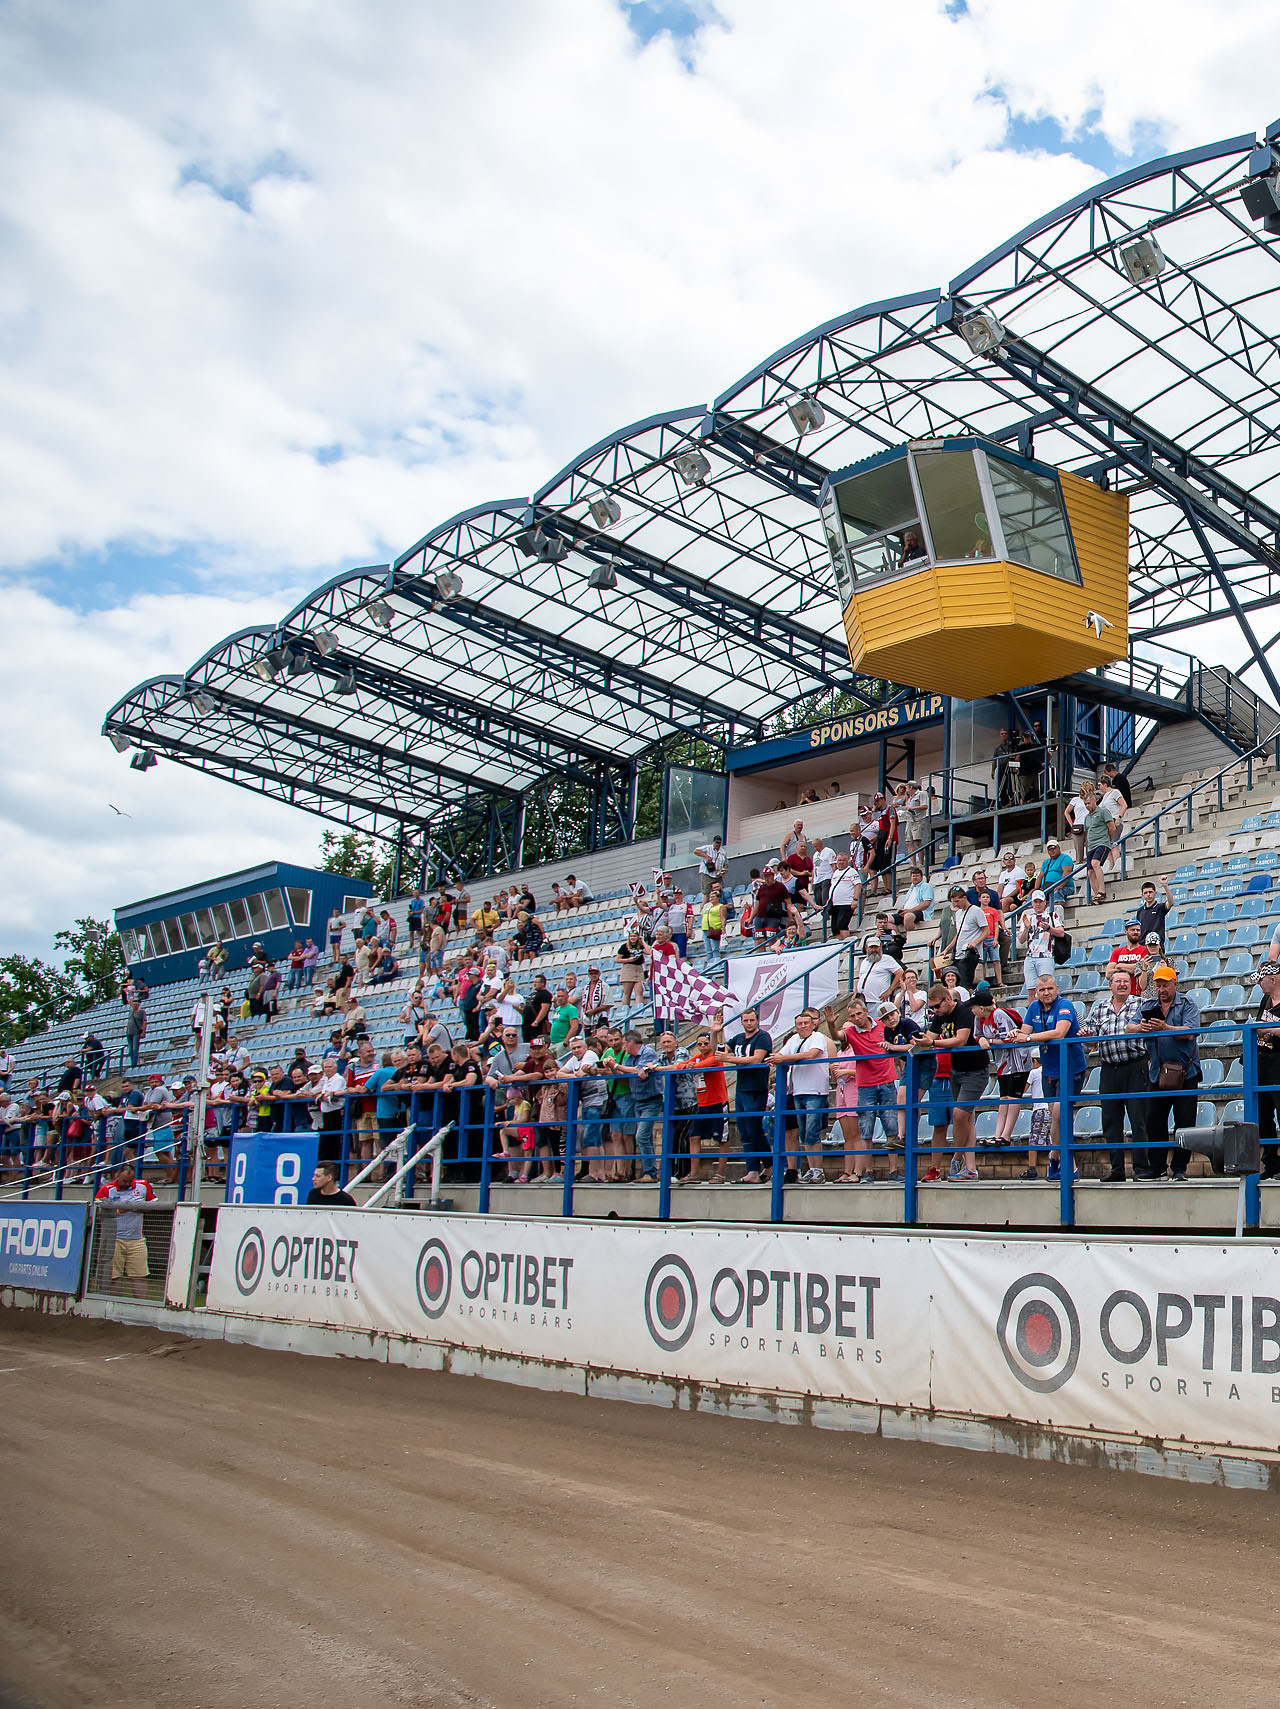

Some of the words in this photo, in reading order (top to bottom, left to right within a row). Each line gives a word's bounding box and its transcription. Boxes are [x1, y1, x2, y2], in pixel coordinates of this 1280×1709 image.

[810, 707, 899, 747] SPONSORS
[905, 695, 944, 721] V.I.P.
[271, 1234, 359, 1284] OPTIBET
[460, 1249, 574, 1310] OPTIBET
[267, 1281, 317, 1296] SPORTA
[709, 1266, 881, 1340] OPTIBET
[459, 1303, 519, 1323] SPORTA
[530, 1311, 573, 1330] BĀRS
[709, 1332, 800, 1355] SPORTA
[820, 1341, 882, 1364] BĀRS
[1101, 1371, 1241, 1401] SPORTA
